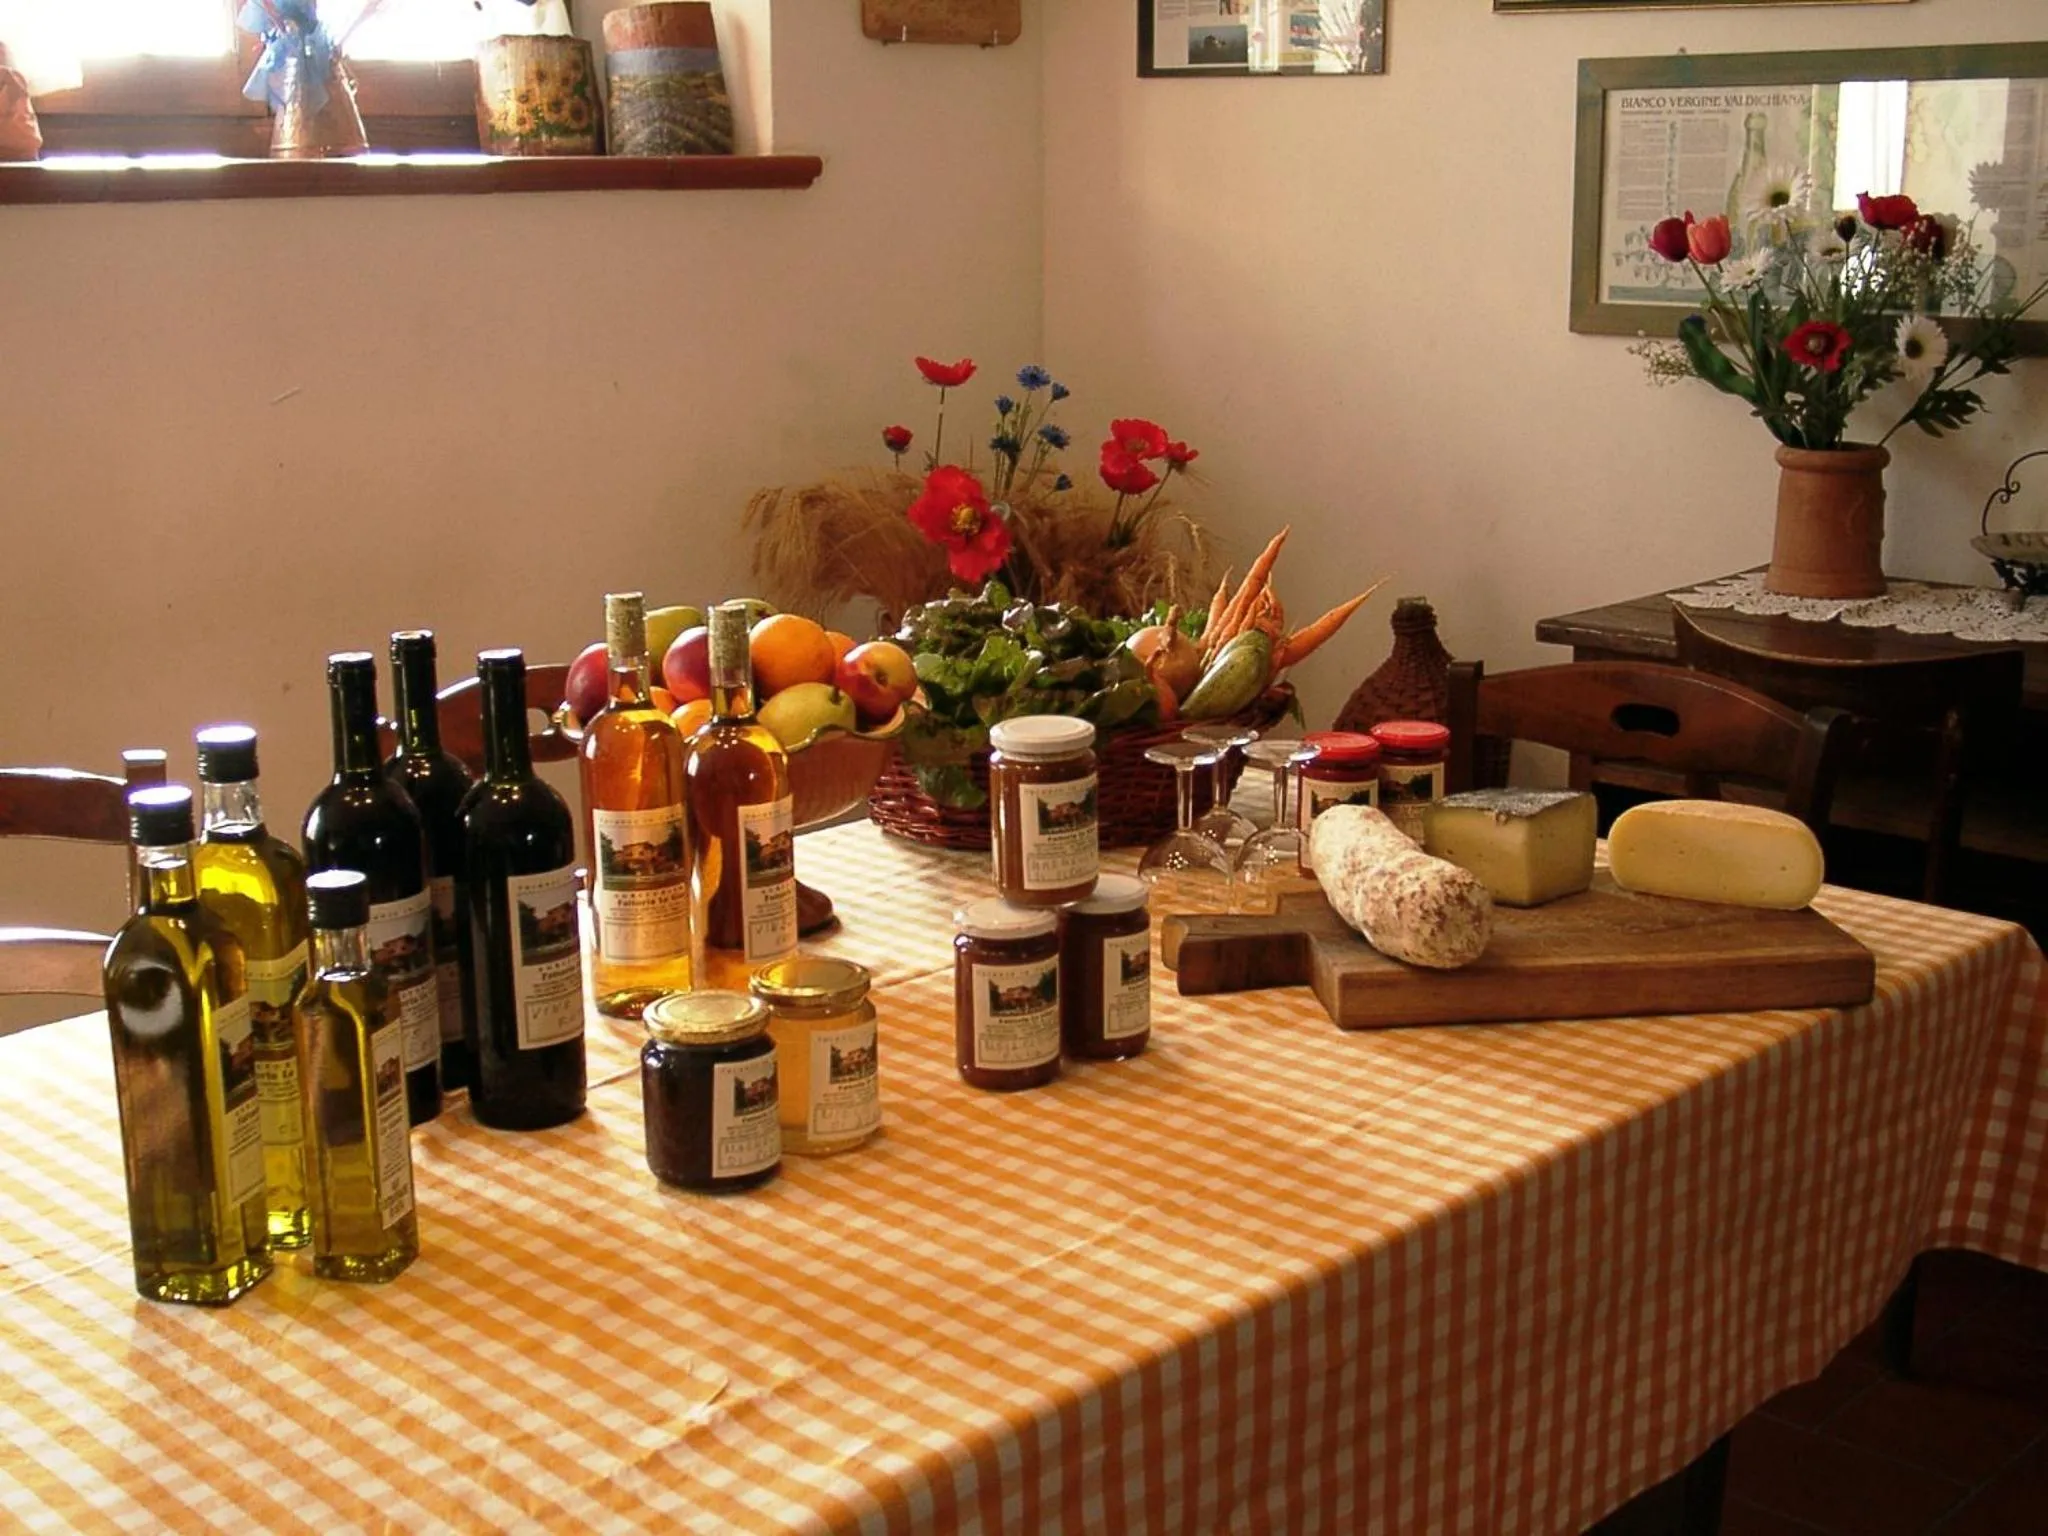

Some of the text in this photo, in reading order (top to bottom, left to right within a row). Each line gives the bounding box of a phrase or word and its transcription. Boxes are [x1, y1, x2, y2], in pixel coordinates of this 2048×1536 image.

[1620, 93, 1807, 109] BIANCO VERGINE VALDICHIANA
